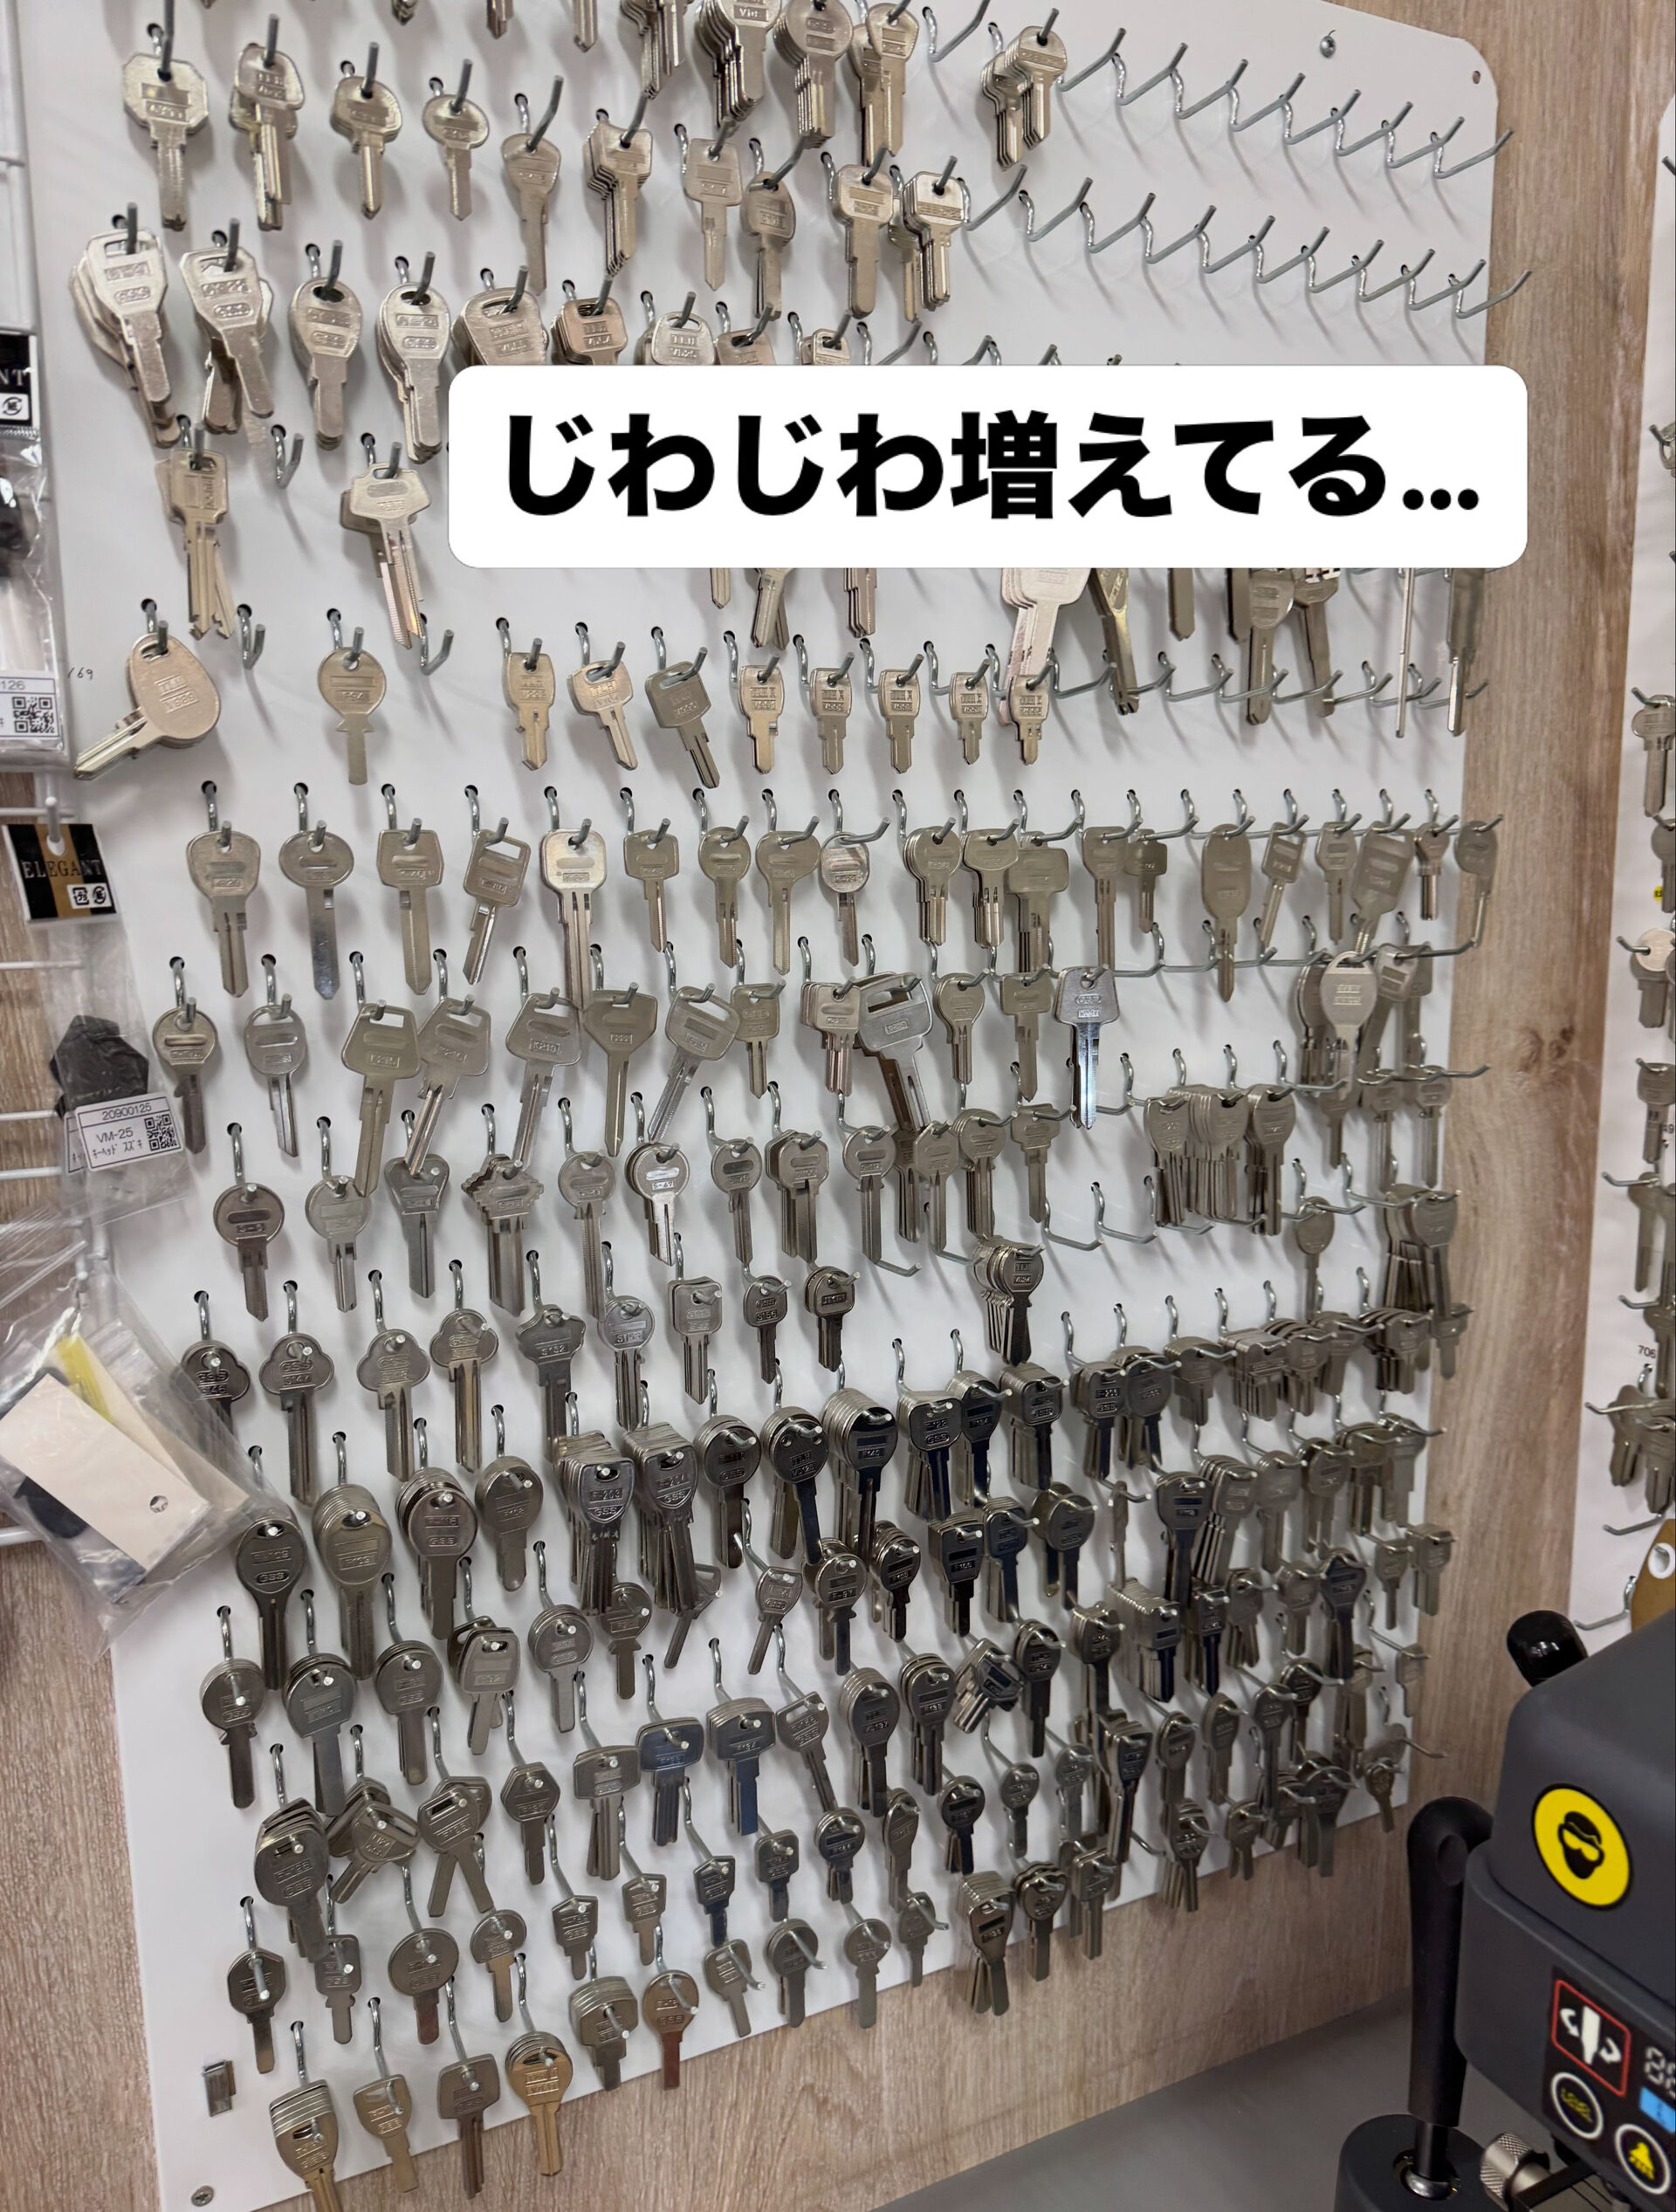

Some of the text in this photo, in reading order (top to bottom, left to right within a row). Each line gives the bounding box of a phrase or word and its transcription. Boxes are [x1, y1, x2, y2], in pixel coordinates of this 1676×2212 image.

[21, 859, 102, 878] ELEGANT
[102, 1103, 152, 1120] 20900125
[96, 1127, 134, 1143] VM-25
[1097, 1402, 1117, 1412] GSS
[925, 1433, 949, 1444] GSS
[663, 1492, 685, 1504] GSS
[594, 1507, 617, 1517] GSS
